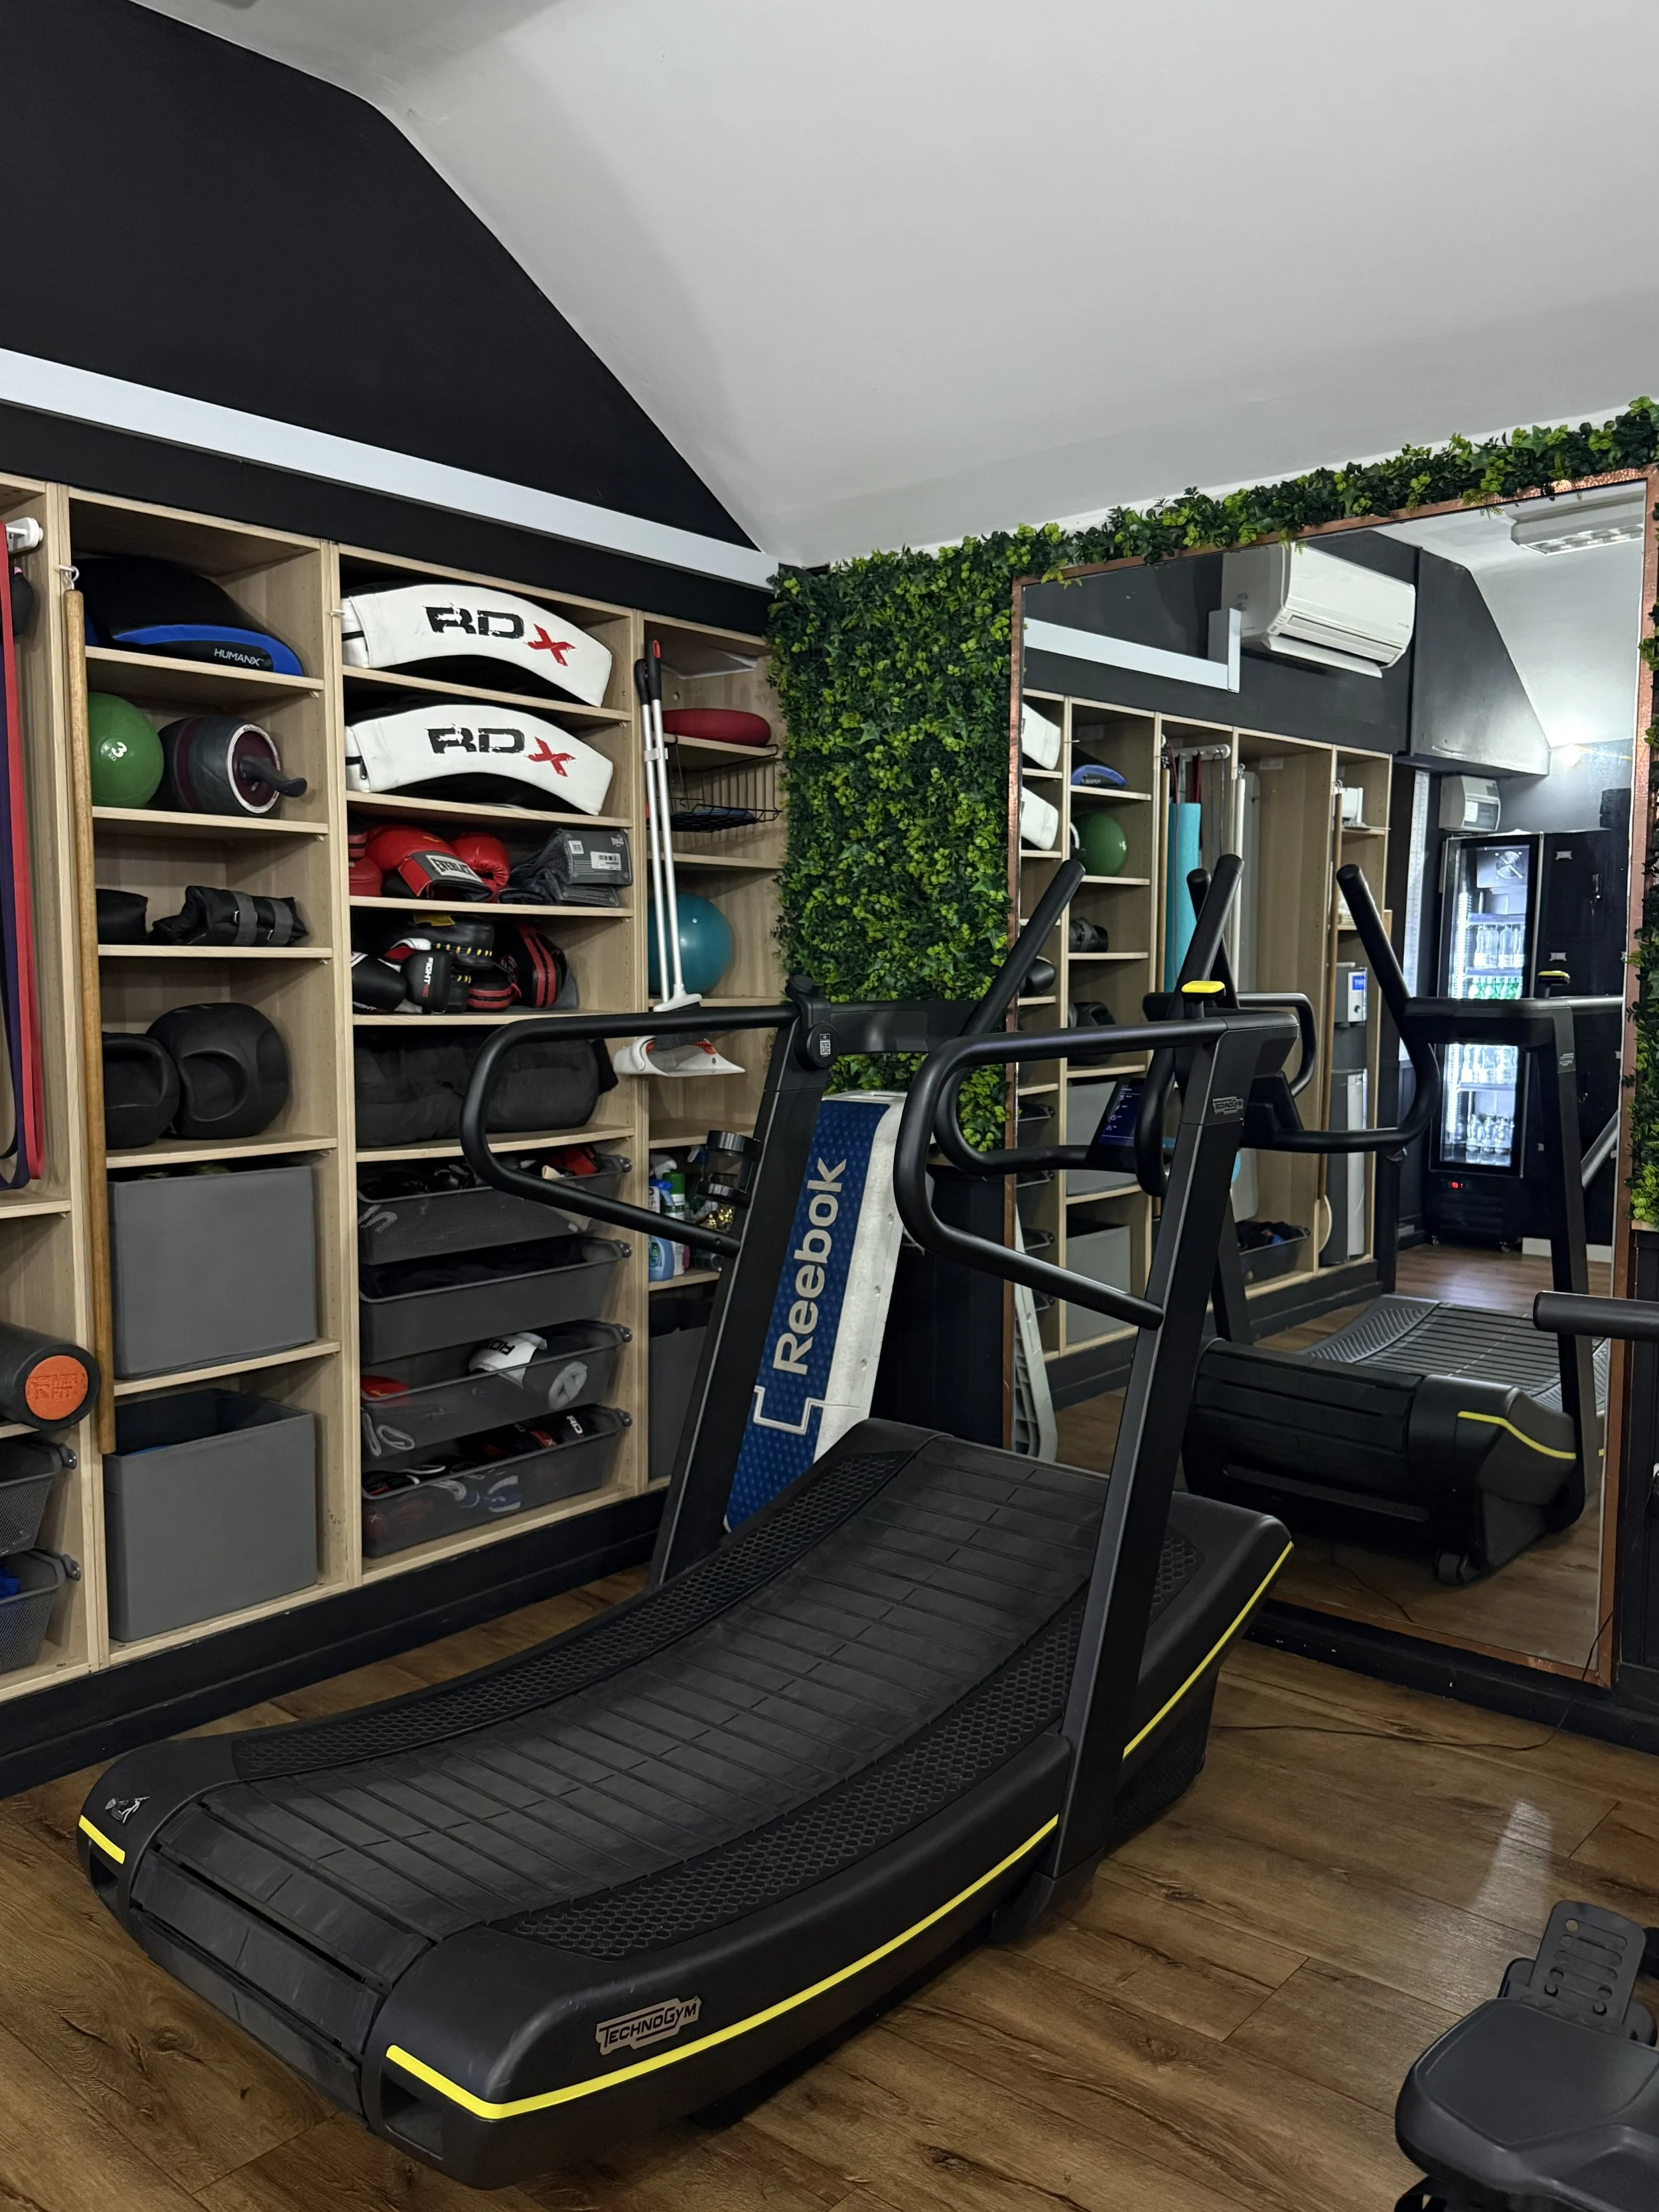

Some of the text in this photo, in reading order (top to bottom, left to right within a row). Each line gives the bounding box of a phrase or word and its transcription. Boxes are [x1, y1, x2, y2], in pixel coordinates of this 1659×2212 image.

[214, 648, 260, 666] HUMANX
[423, 603, 577, 666] RDX
[111, 741, 127, 758] 3
[425, 723, 577, 777] RDX
[772, 1157, 846, 1375] Reebok
[488, 1339, 516, 1356] RD
[599, 2003, 697, 2048] TECHNOGYM
